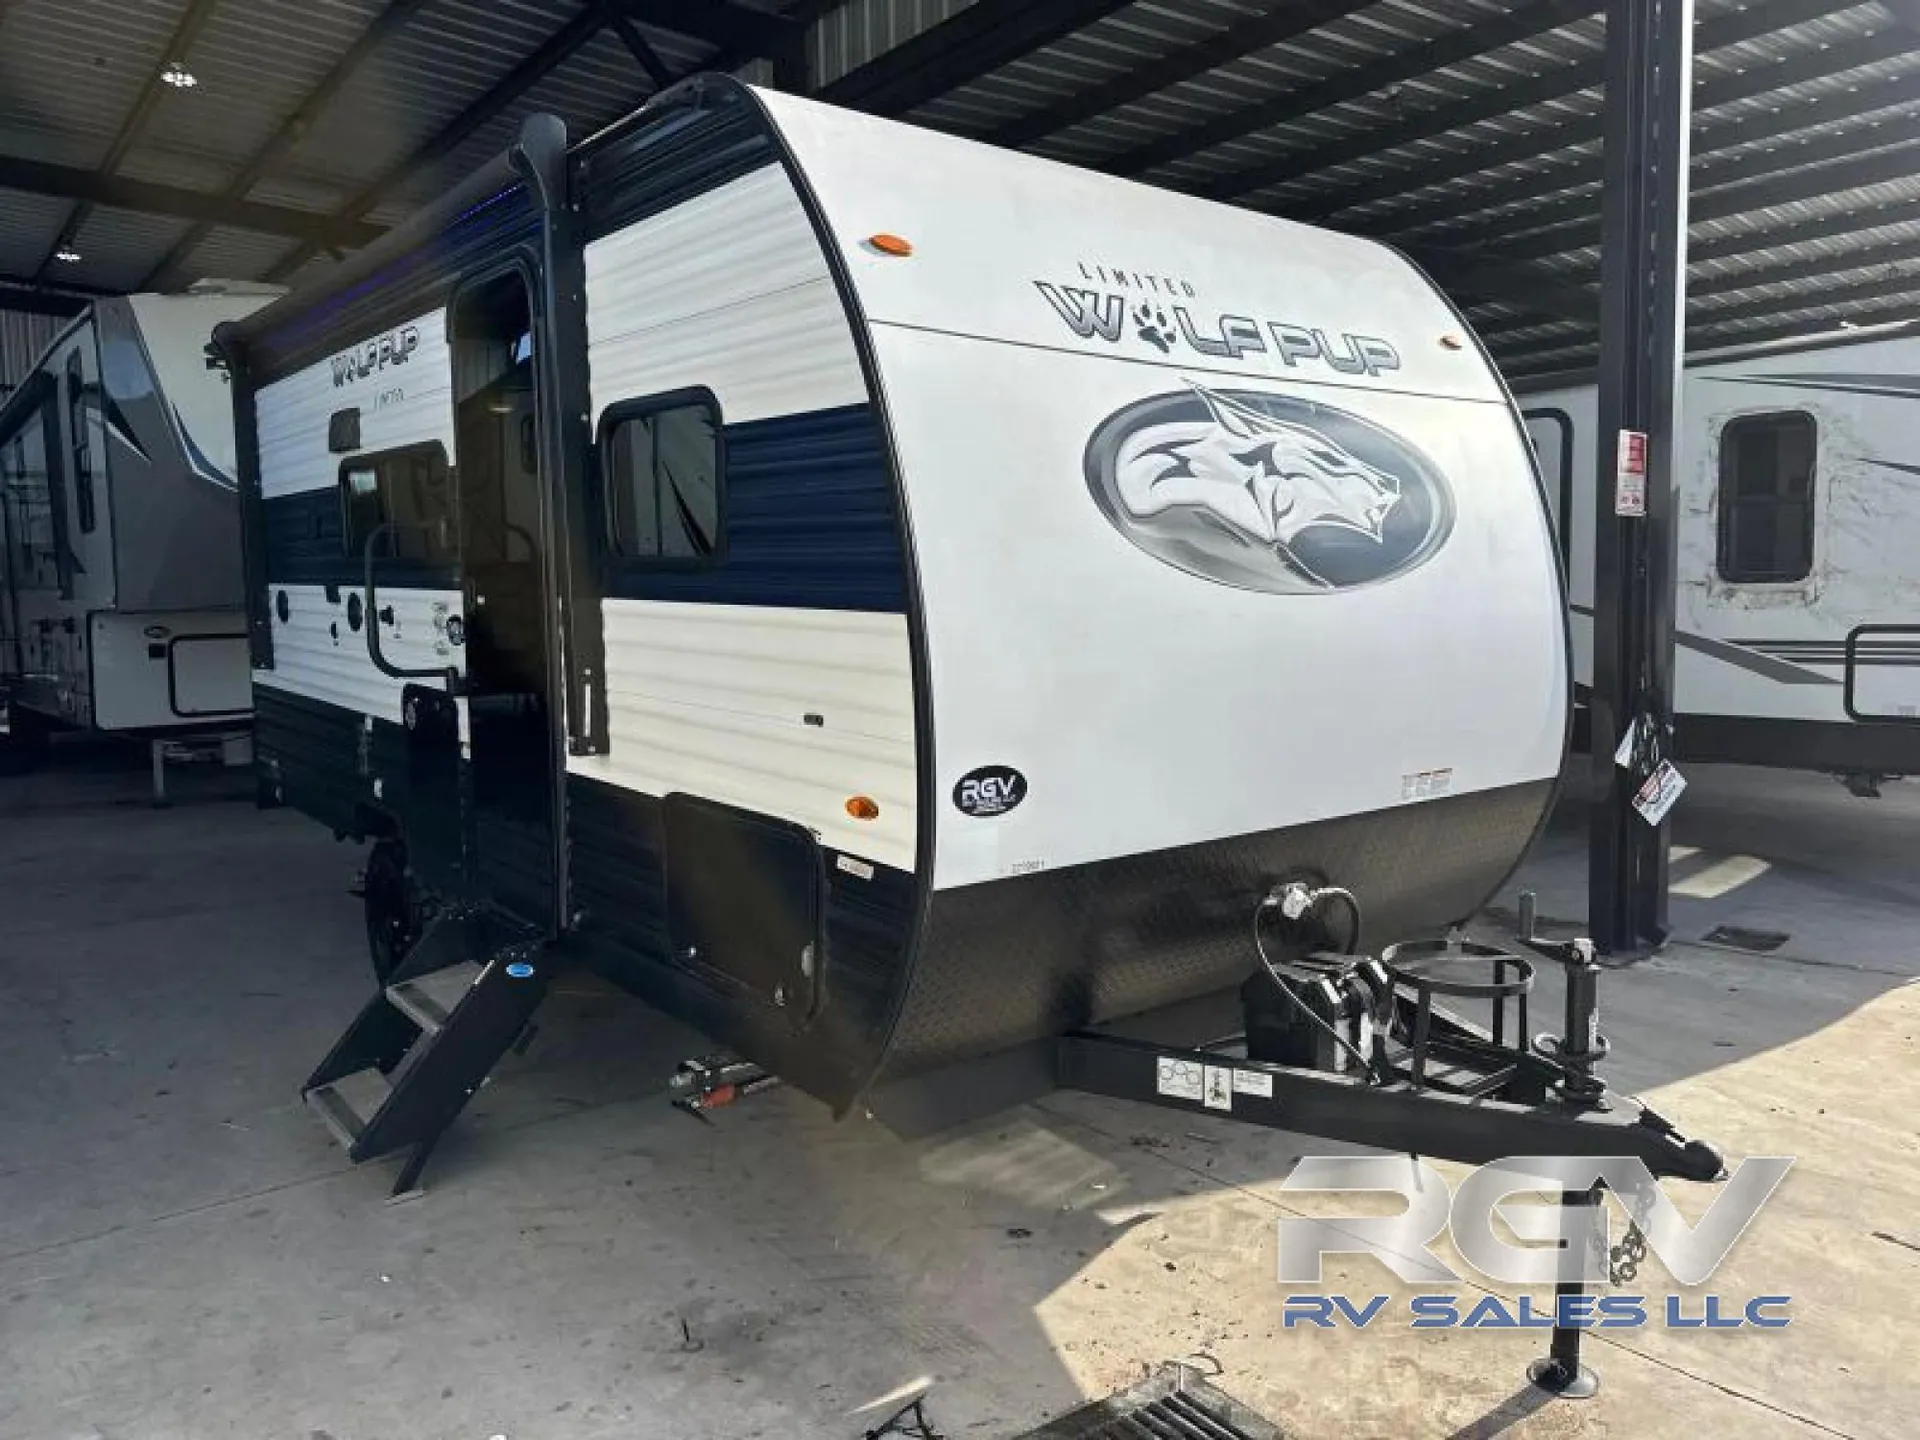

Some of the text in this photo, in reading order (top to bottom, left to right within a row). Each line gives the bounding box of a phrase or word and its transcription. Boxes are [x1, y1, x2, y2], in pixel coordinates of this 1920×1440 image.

[1077, 260, 1196, 298] LIMITED
[1267, 320, 1401, 376] PUP
[961, 774, 1016, 802] RGV
